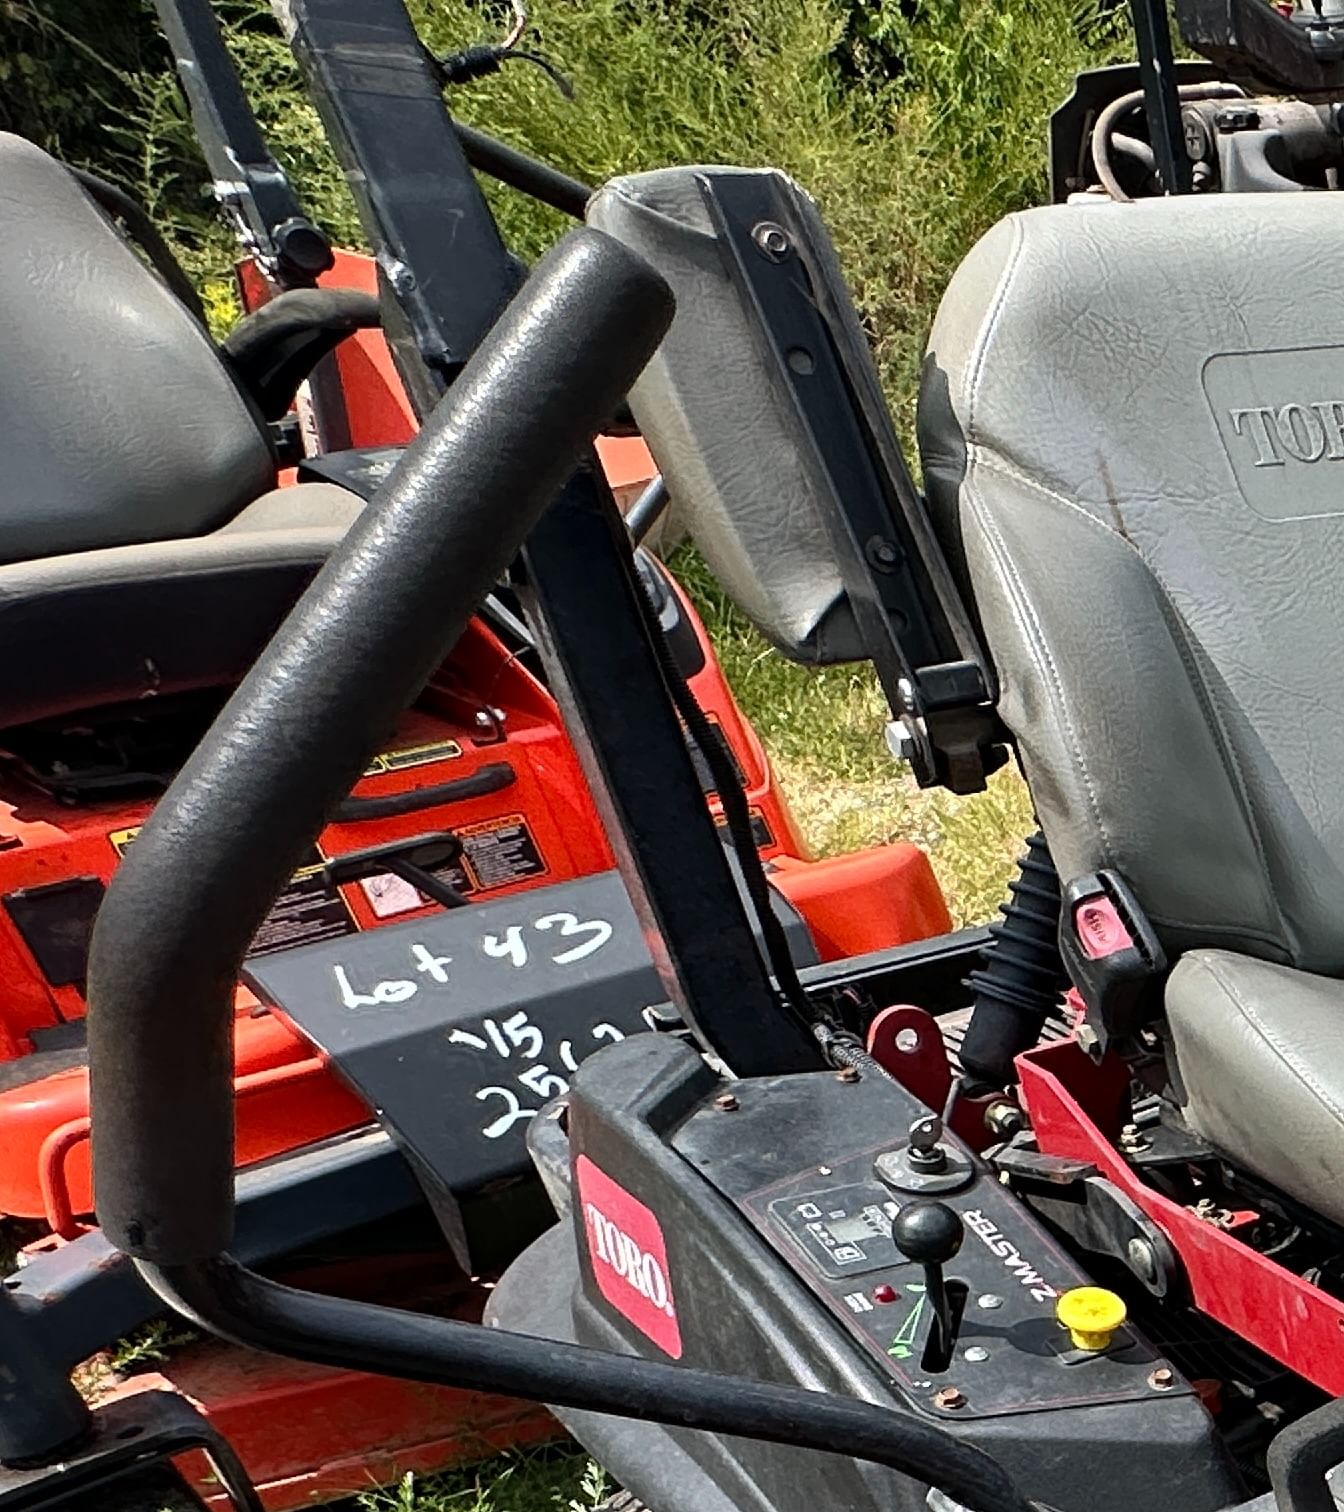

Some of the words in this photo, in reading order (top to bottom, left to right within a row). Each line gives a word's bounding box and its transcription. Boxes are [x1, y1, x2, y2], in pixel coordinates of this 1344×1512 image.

[333, 943, 453, 1010] Lot
[482, 912, 613, 967] 43
[586, 1202, 668, 1309] TORO
